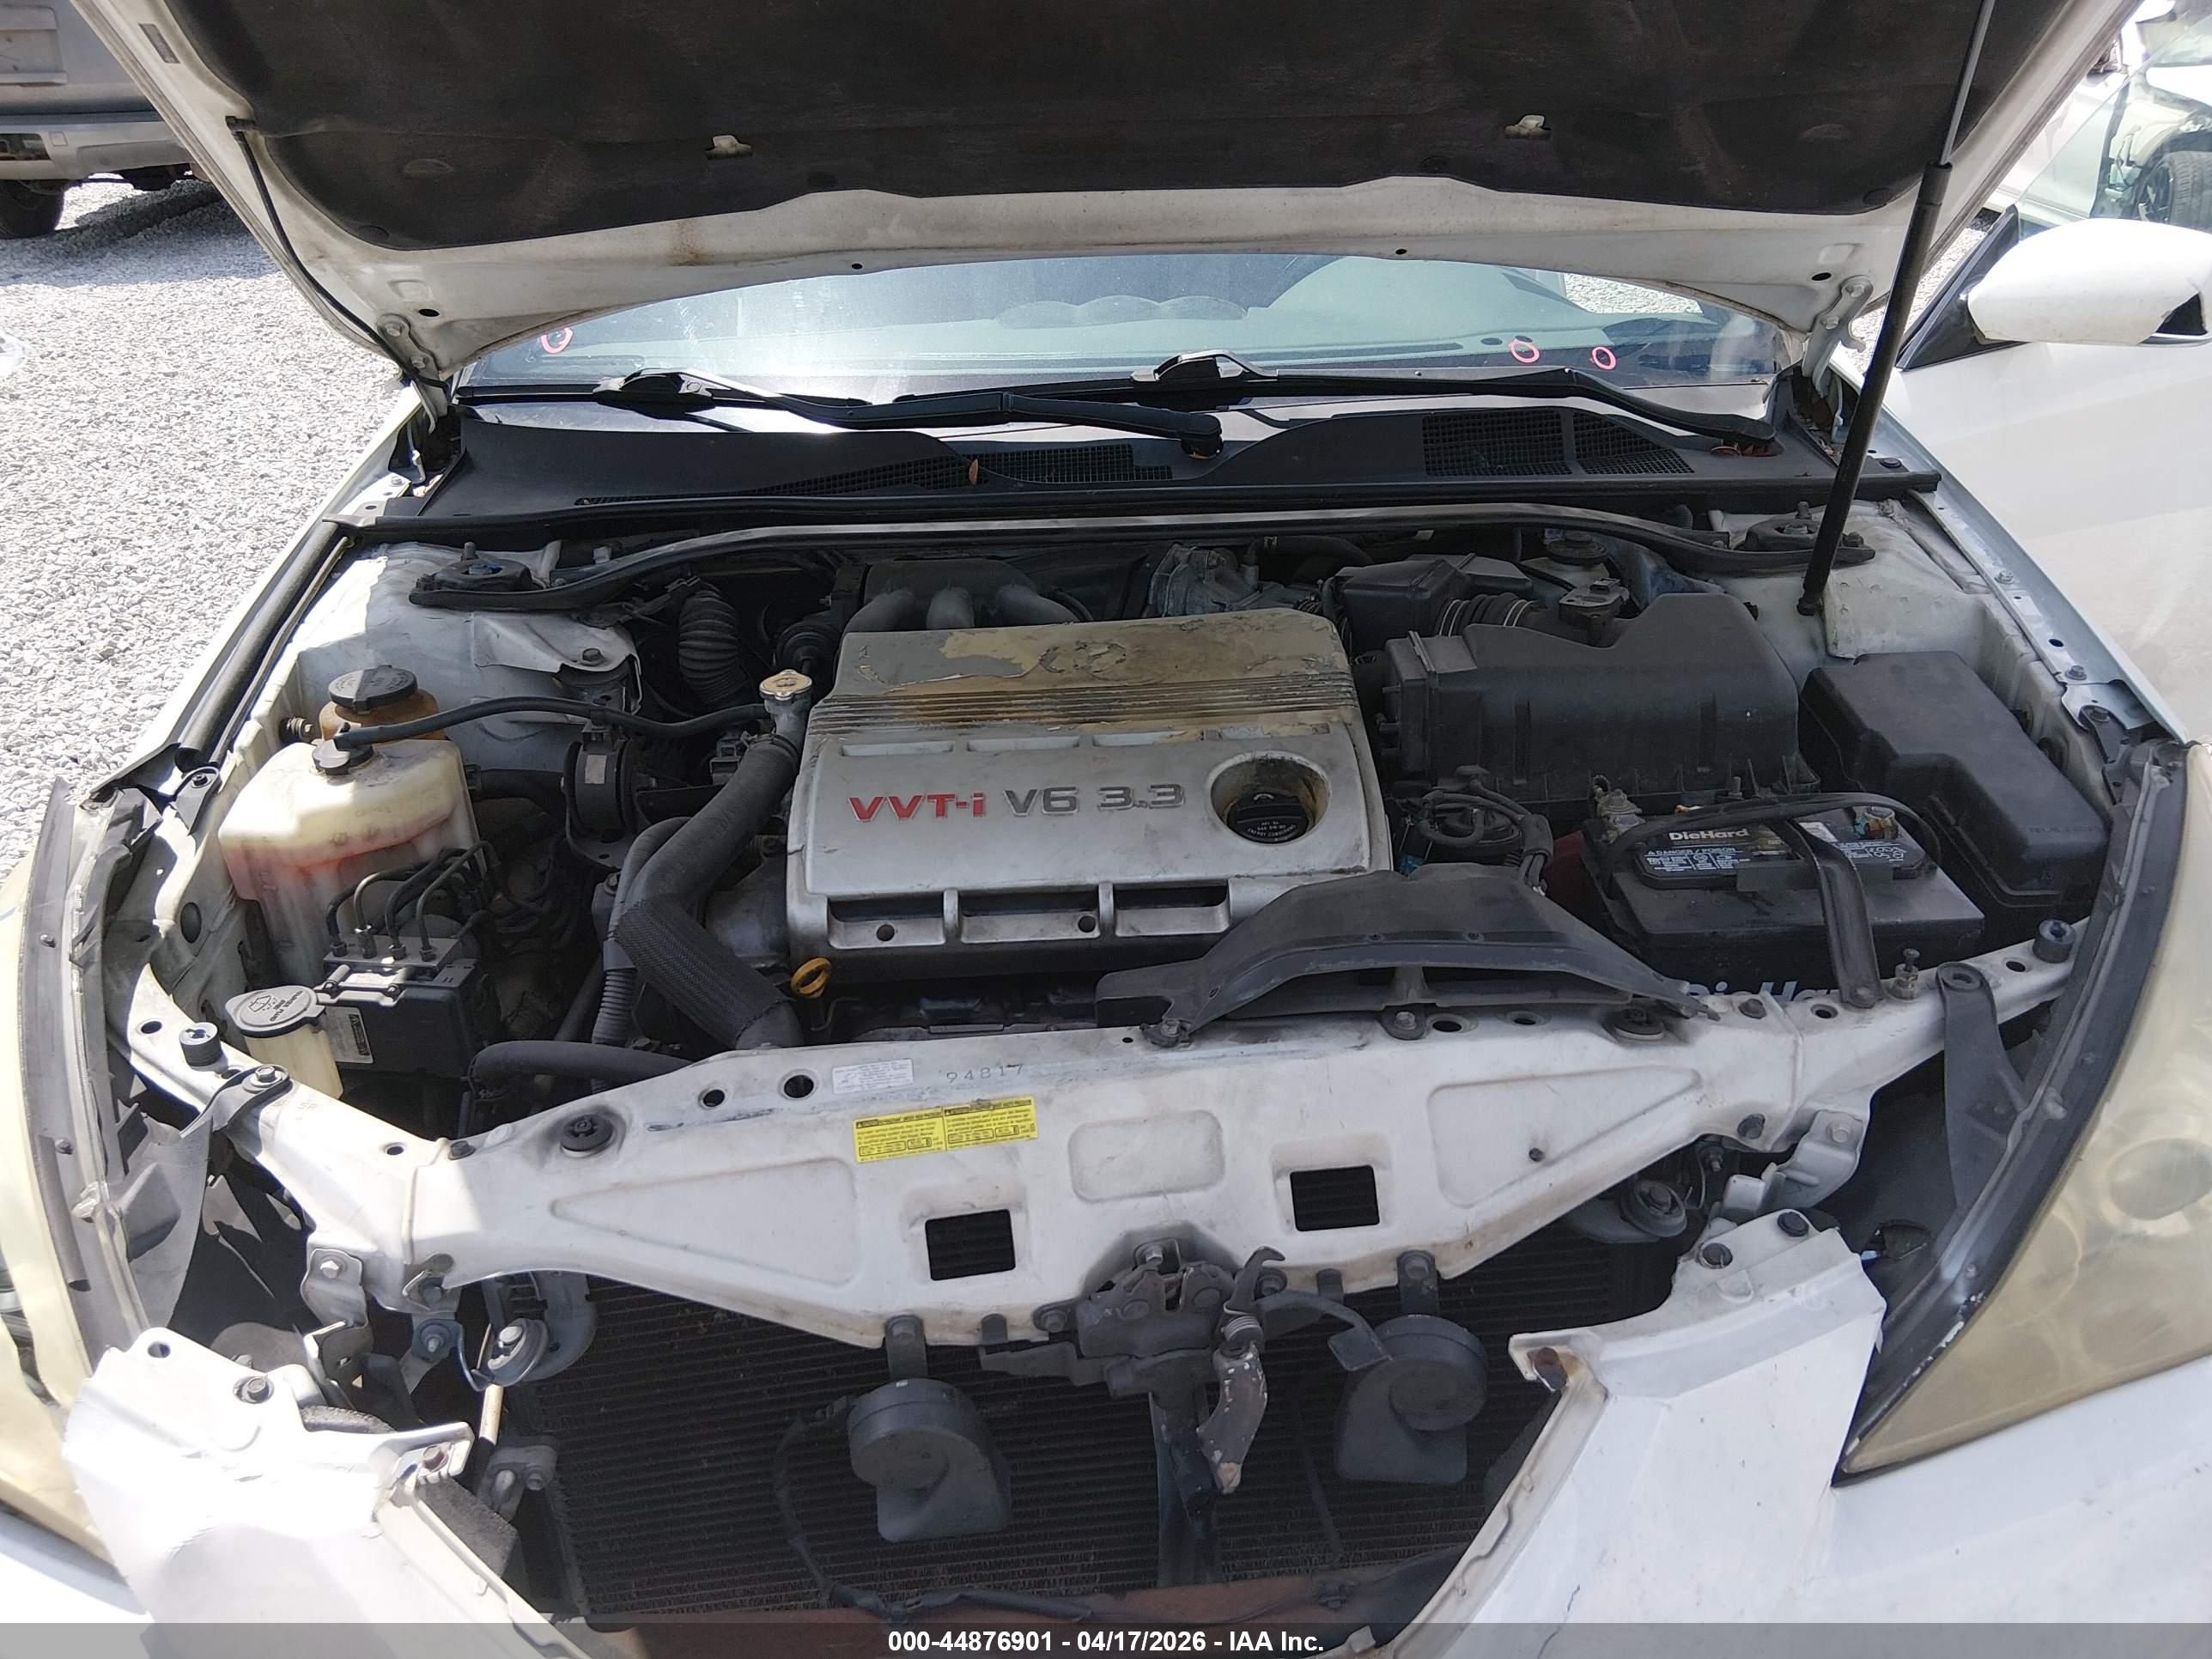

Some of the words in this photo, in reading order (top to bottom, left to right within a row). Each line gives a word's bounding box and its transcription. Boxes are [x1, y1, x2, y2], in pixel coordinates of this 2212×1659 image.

[848, 792, 987, 823] VVT-i
[1003, 786, 1079, 817] V6
[1097, 782, 1186, 811] 3.3
[1668, 828, 1749, 841] DieHard
[945, 1064, 1024, 1083] 94817
